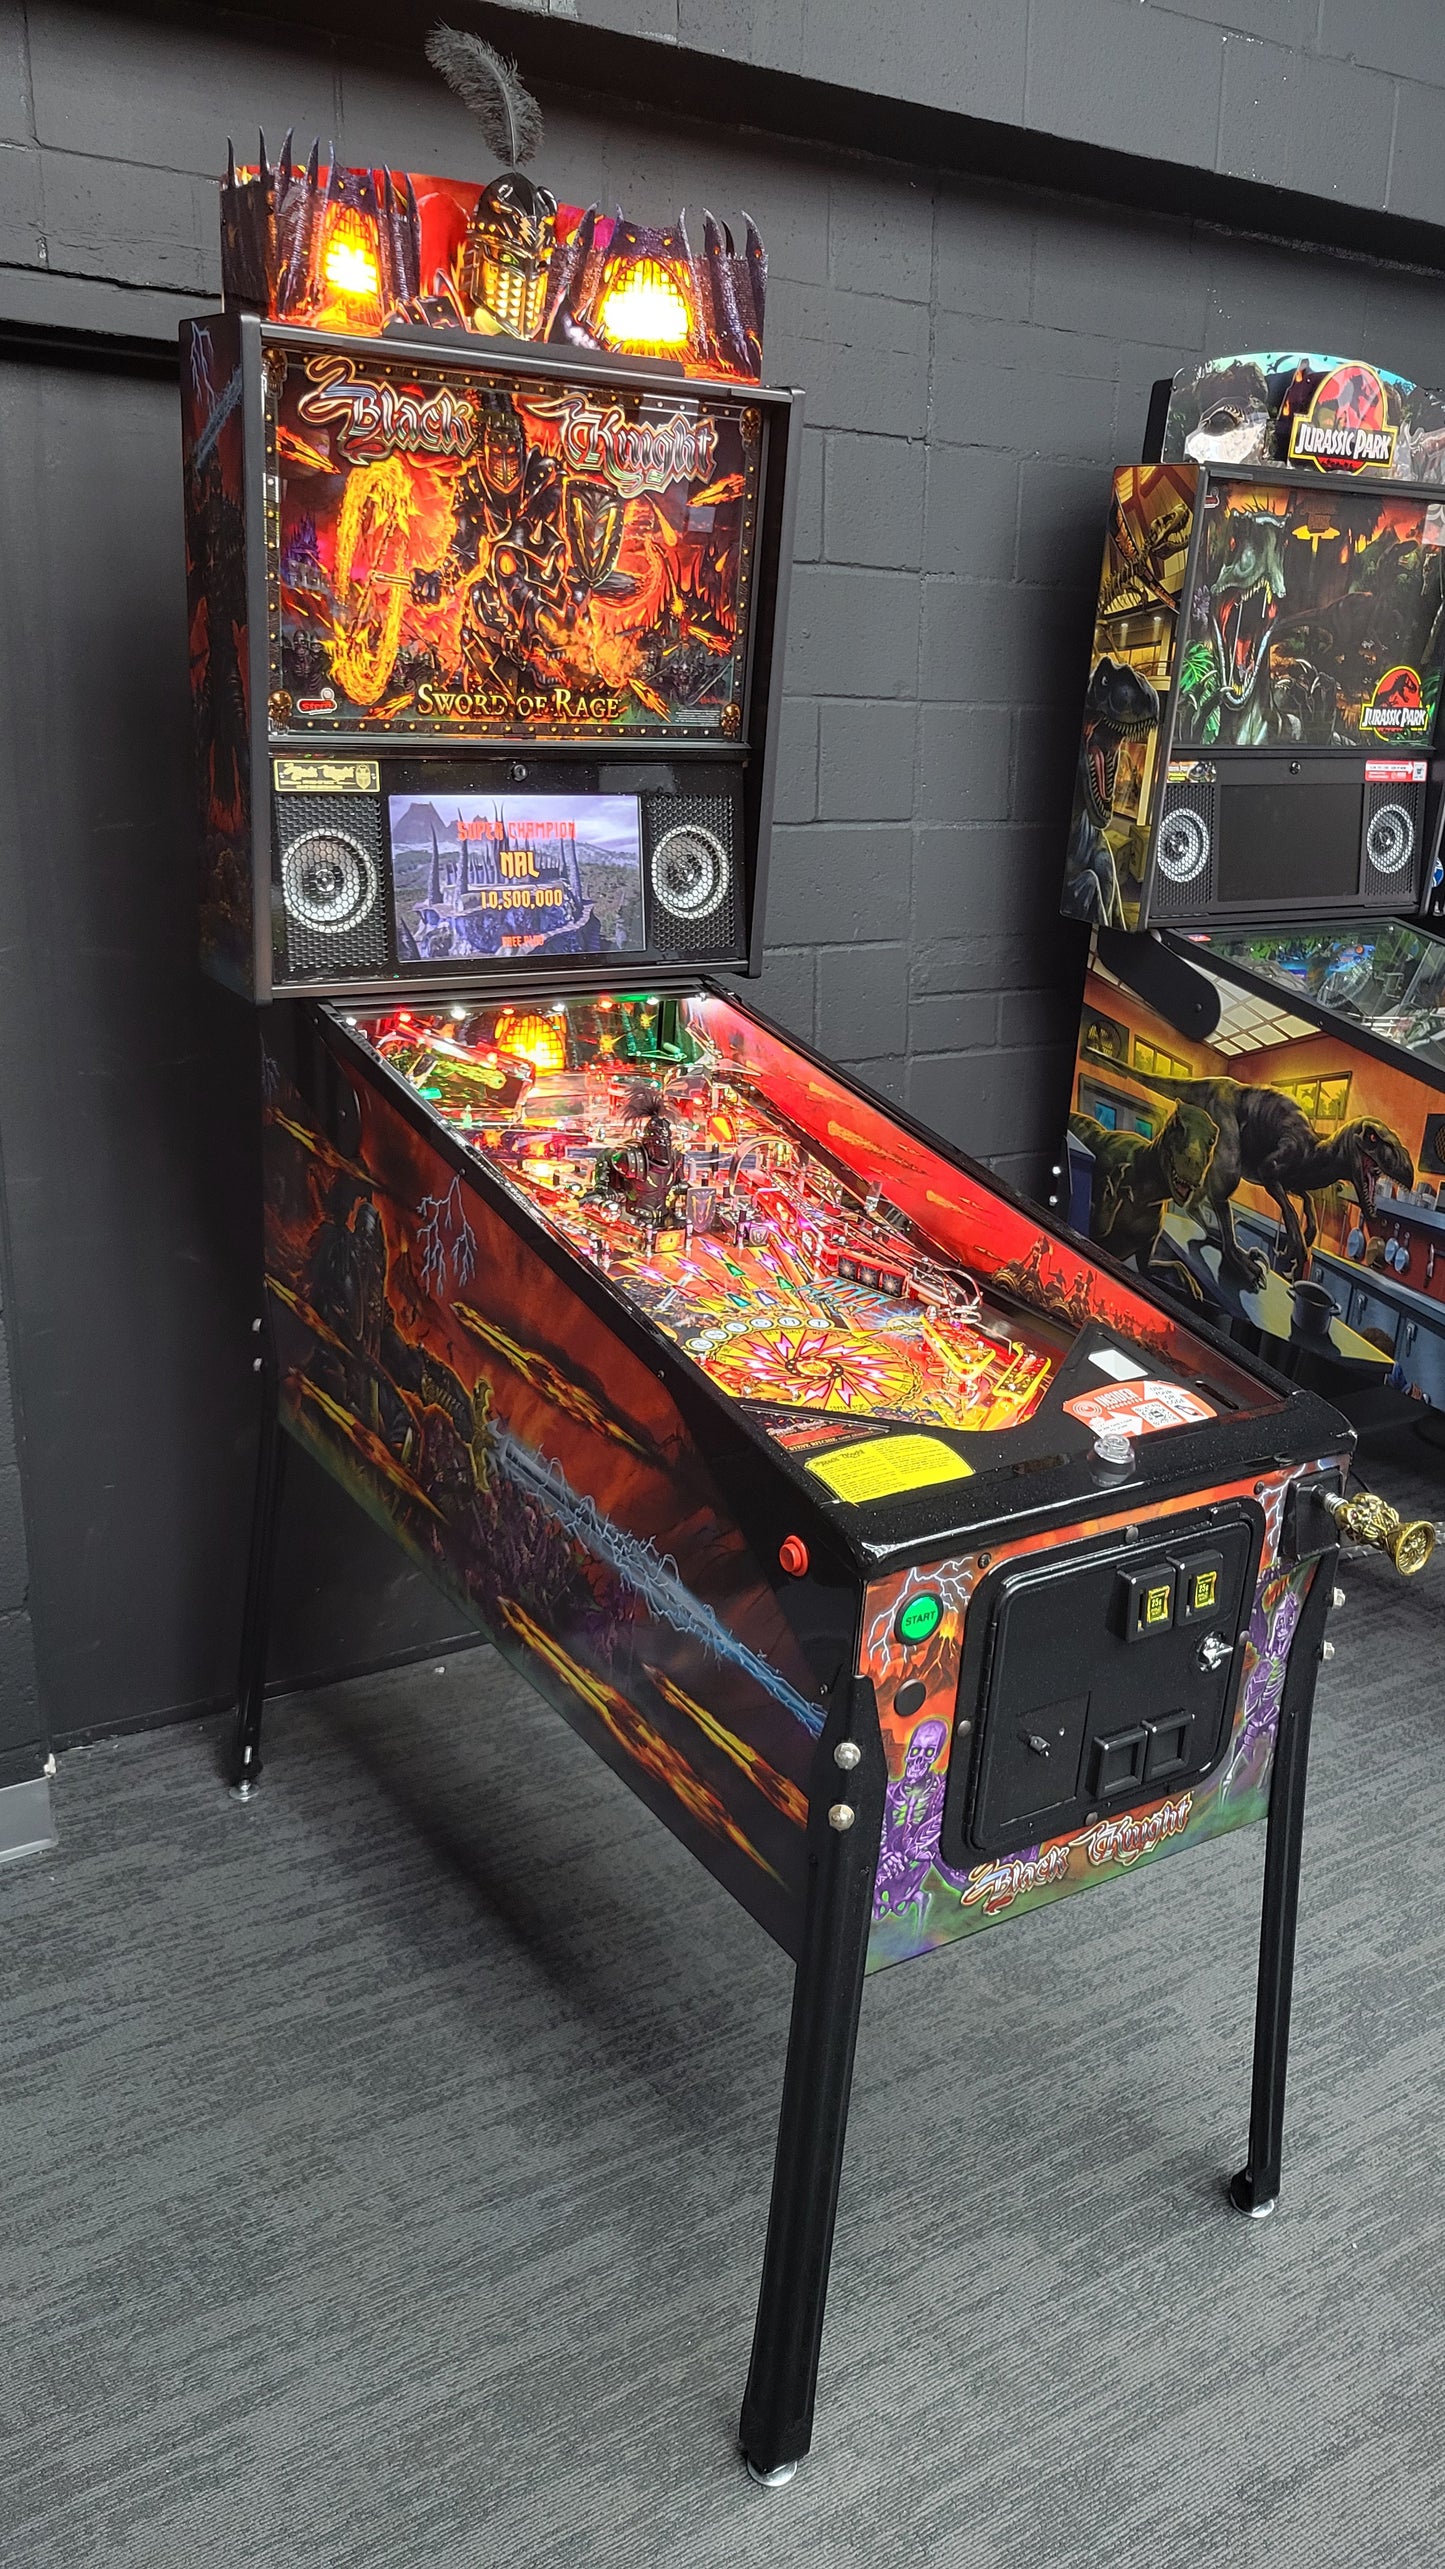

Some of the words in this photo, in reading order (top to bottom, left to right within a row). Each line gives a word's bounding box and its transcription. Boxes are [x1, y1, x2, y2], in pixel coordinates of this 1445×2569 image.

[298, 355, 476, 466] Black
[526, 392, 718, 499] Knight
[1294, 422, 1355, 457] JURASSIC
[1352, 429, 1392, 460] PARK
[1362, 707, 1402, 727] JURASSIC
[1400, 707, 1426, 728] PARK
[456, 820, 505, 841] SUPER
[508, 821, 577, 840] CHAMPION
[499, 850, 540, 880] NAL
[480, 888, 563, 911] 10,500,000
[1094, 1388, 1139, 1408] INSIDER
[904, 1610, 936, 1627] START
[961, 1846, 1070, 1916] Black
[1068, 1790, 1195, 1867] Knight
